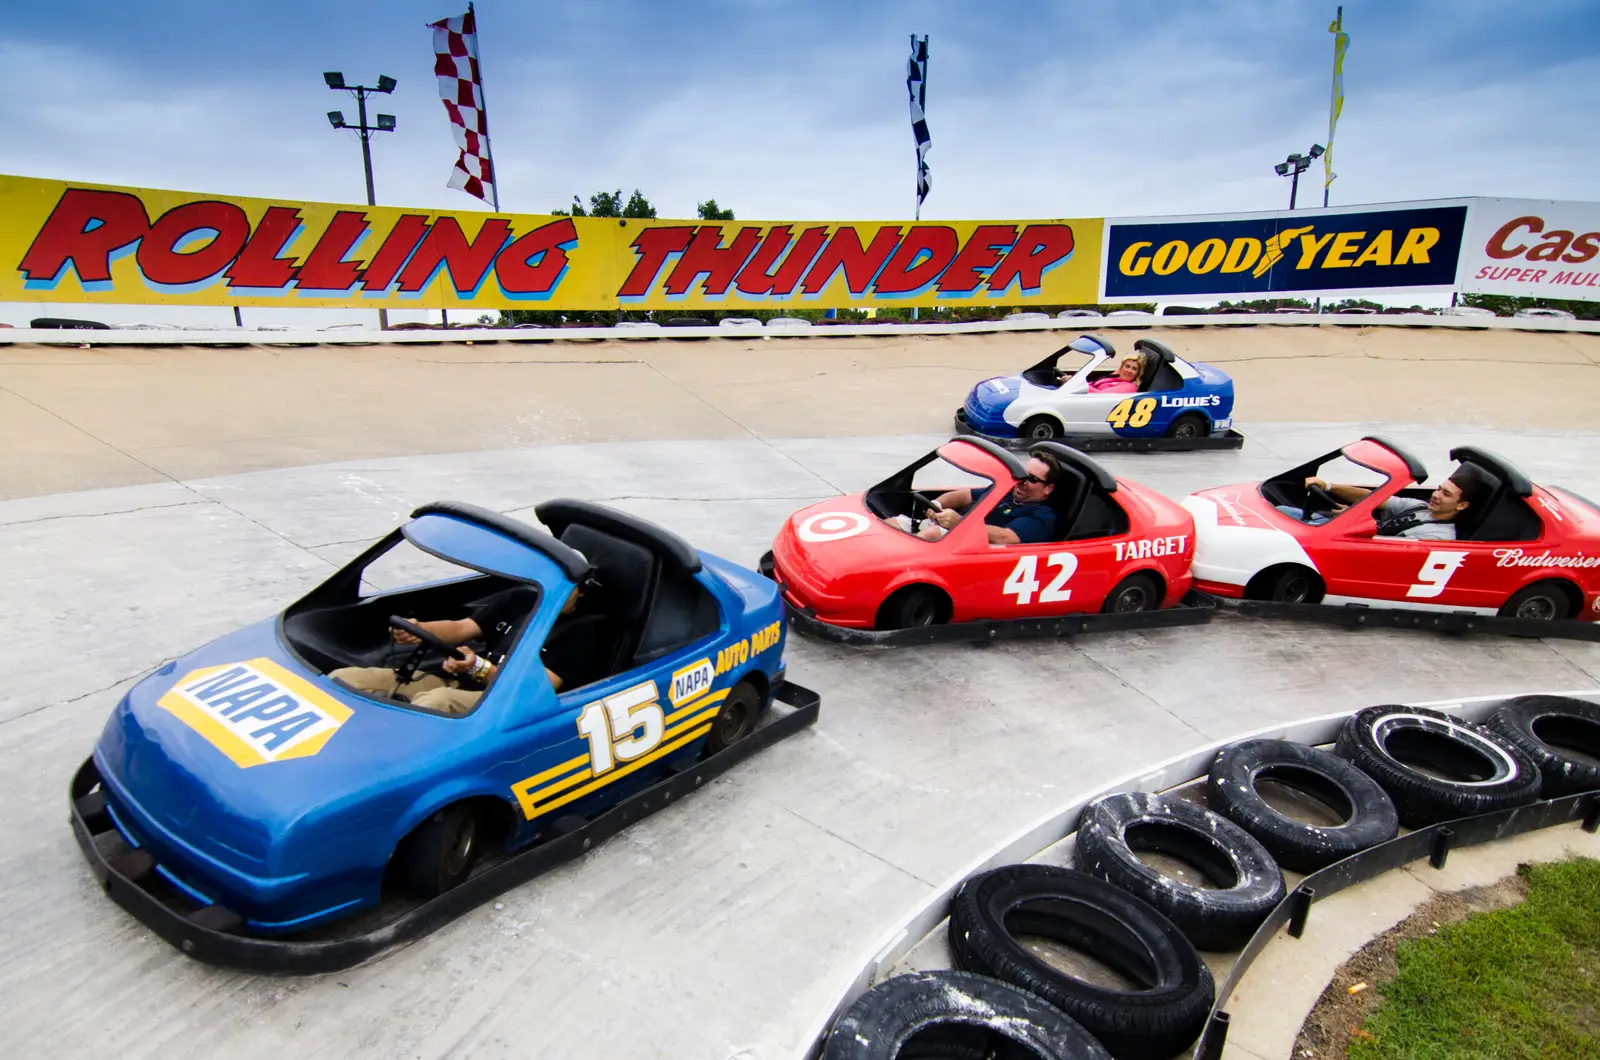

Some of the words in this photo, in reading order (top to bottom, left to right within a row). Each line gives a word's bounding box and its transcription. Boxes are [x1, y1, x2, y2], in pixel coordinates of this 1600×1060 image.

[17, 187, 579, 300] ROLLING
[615, 224, 1075, 302] THUNDER
[1474, 265, 1549, 283] SUPER
[1548, 271, 1600, 288] MUL
[1106, 397, 1157, 429] 48
[1112, 535, 1188, 562] TARGET
[1492, 548, 1600, 568] Budweiser
[1002, 552, 1079, 605] 42
[1405, 550, 1470, 598] 9
[675, 666, 710, 700] NAPA
[715, 638, 749, 677] AUTO
[750, 620, 781, 659] PARTS
[185, 665, 325, 753] NAPA
[576, 679, 665, 778] 15
